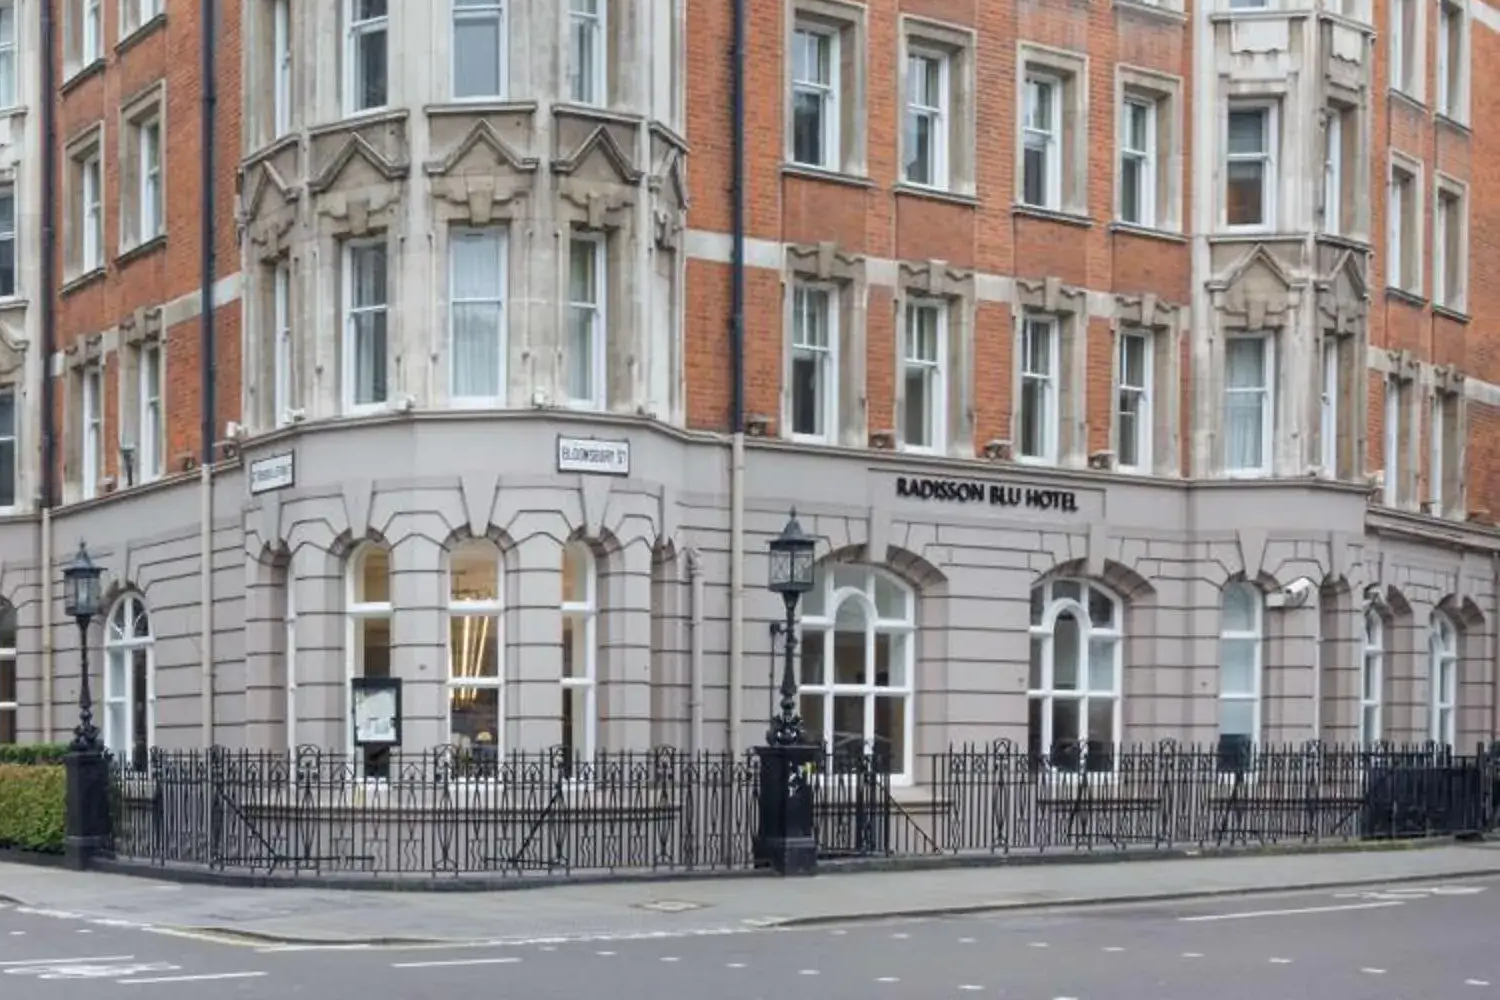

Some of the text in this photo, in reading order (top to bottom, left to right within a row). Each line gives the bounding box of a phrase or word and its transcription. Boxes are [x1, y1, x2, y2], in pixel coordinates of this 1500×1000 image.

[896, 477, 1078, 512] RADISSON BLU HOTEL
